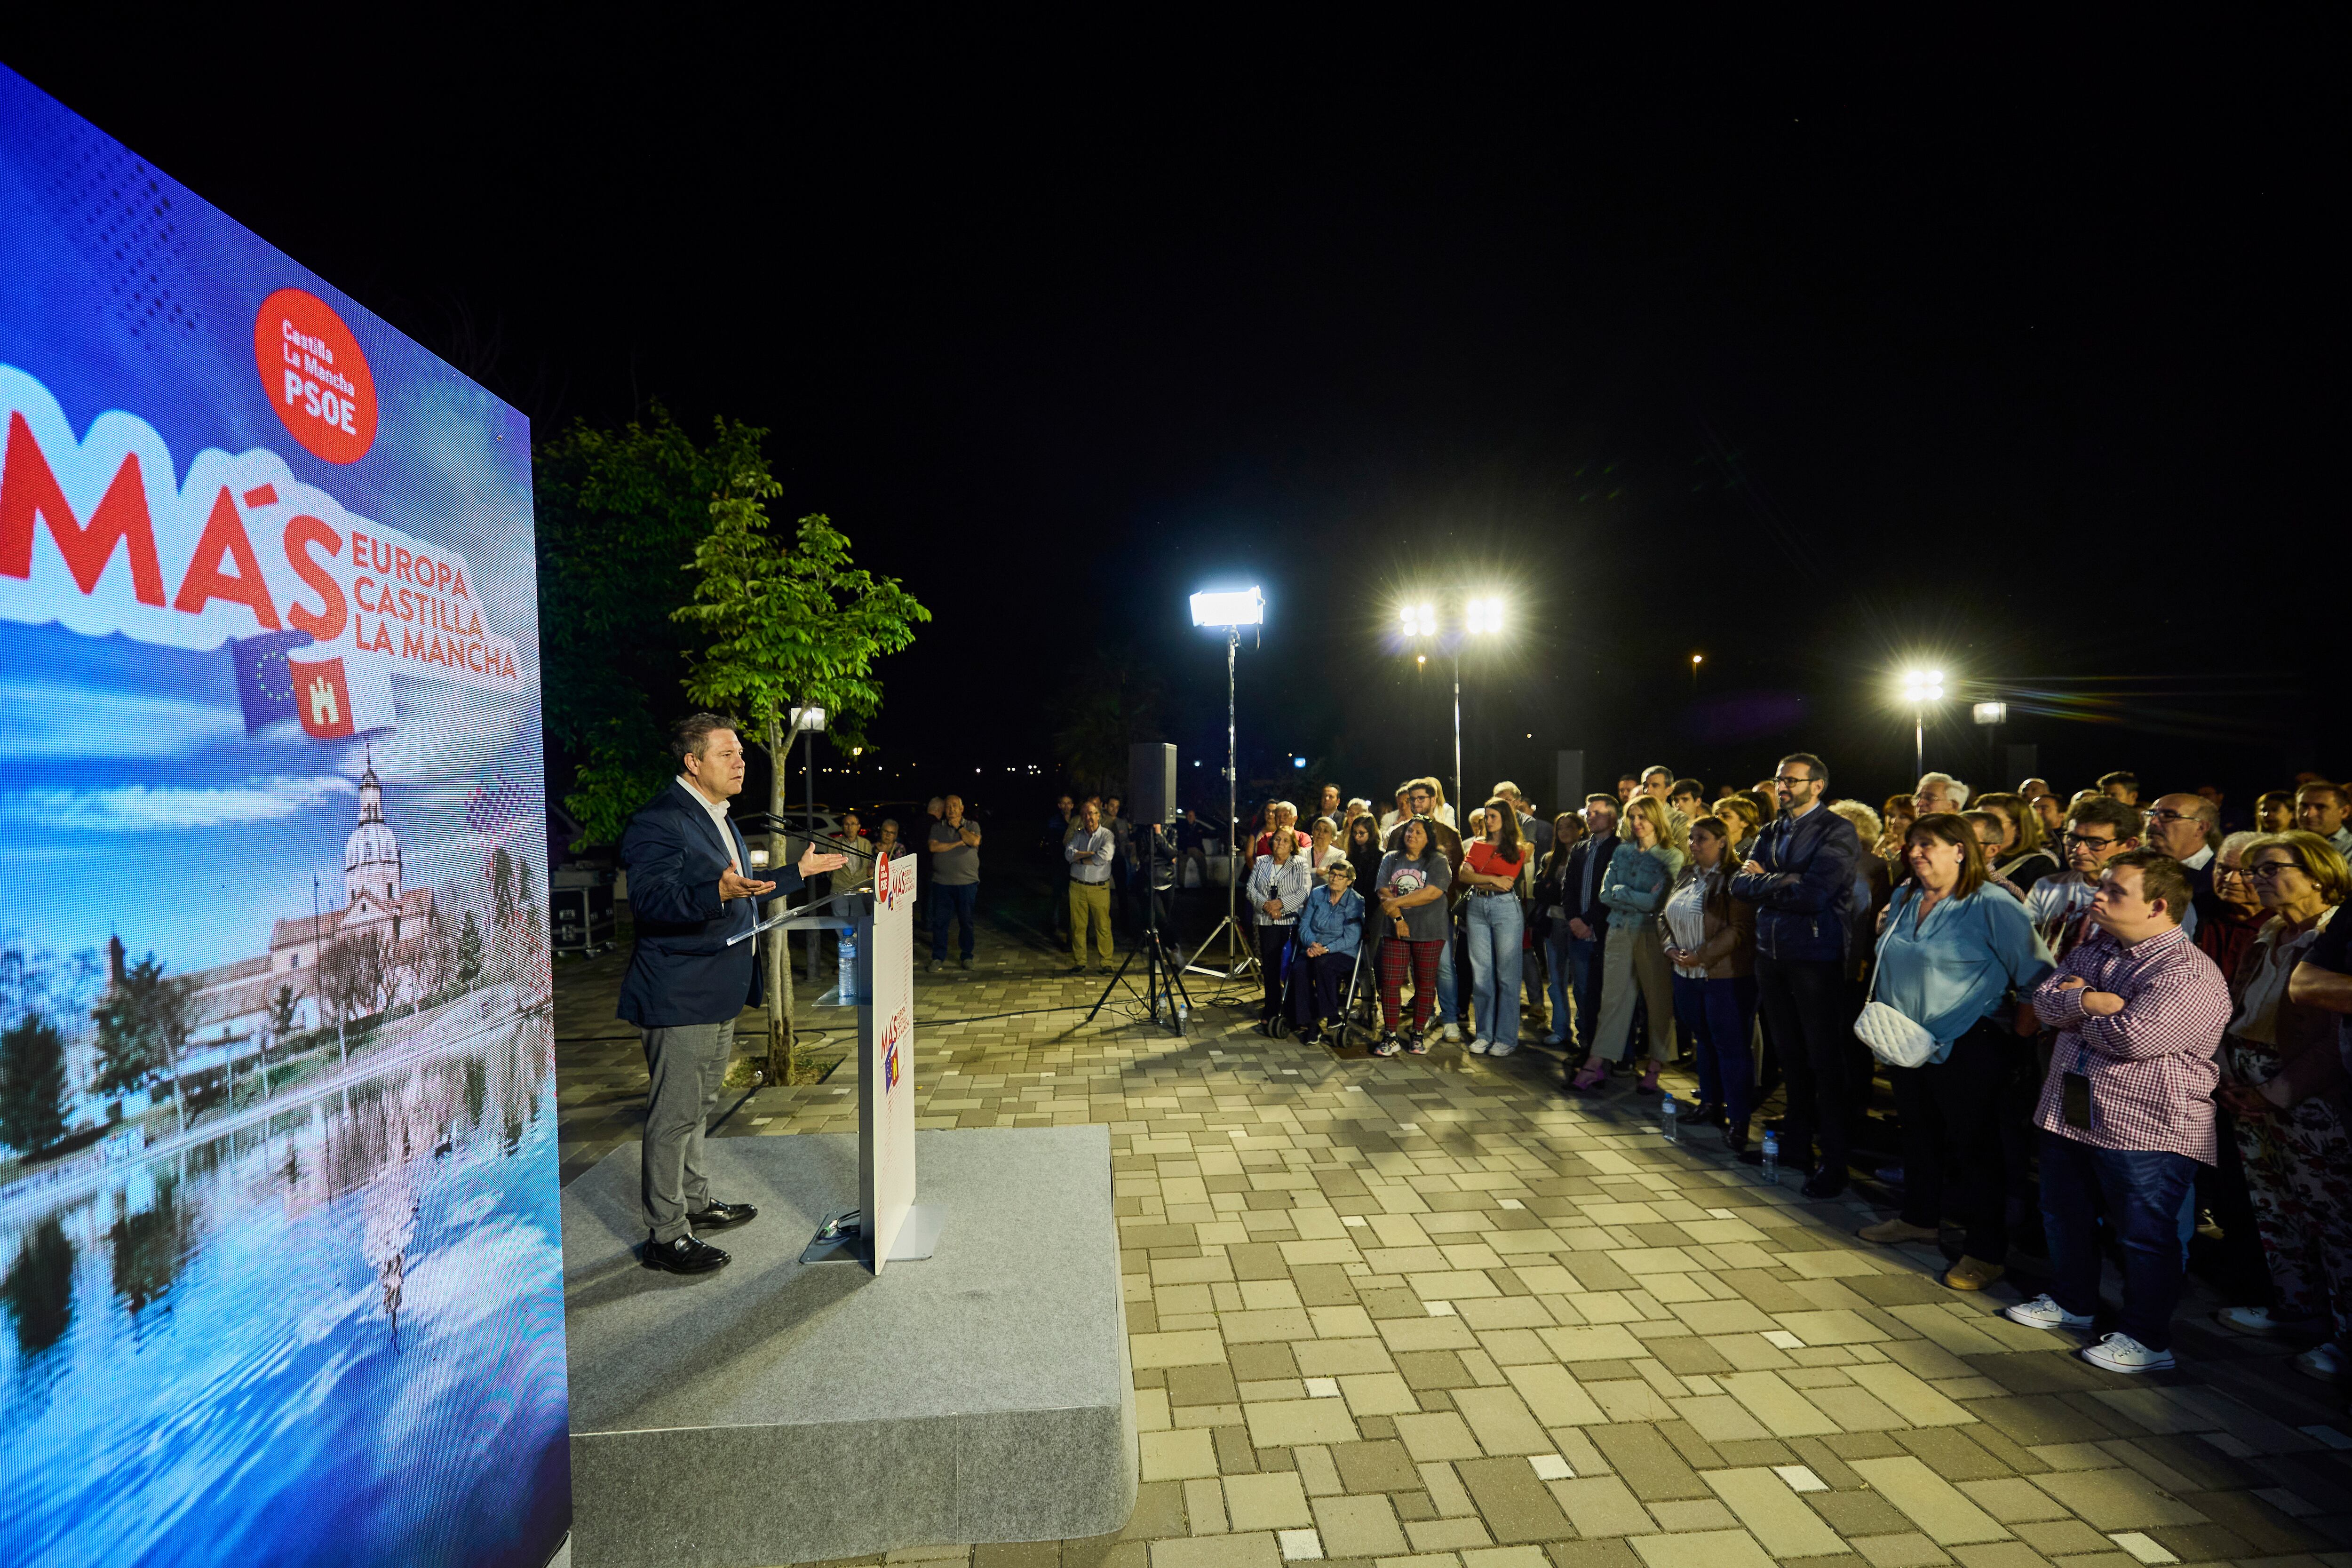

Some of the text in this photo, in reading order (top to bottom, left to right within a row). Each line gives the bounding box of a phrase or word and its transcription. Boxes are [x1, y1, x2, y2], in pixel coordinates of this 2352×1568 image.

[282, 319, 333, 365] Castilla
[283, 342, 355, 398] La Mancha
[285, 368, 356, 436] PSOE
[0, 409, 348, 642] MÁS
[352, 530, 469, 600] EUROPA
[354, 576, 484, 640] CASTILLA
[355, 613, 517, 679] LA MANCHA
[892, 869, 905, 898] MÁS
[881, 1015, 897, 1059] MÁS
